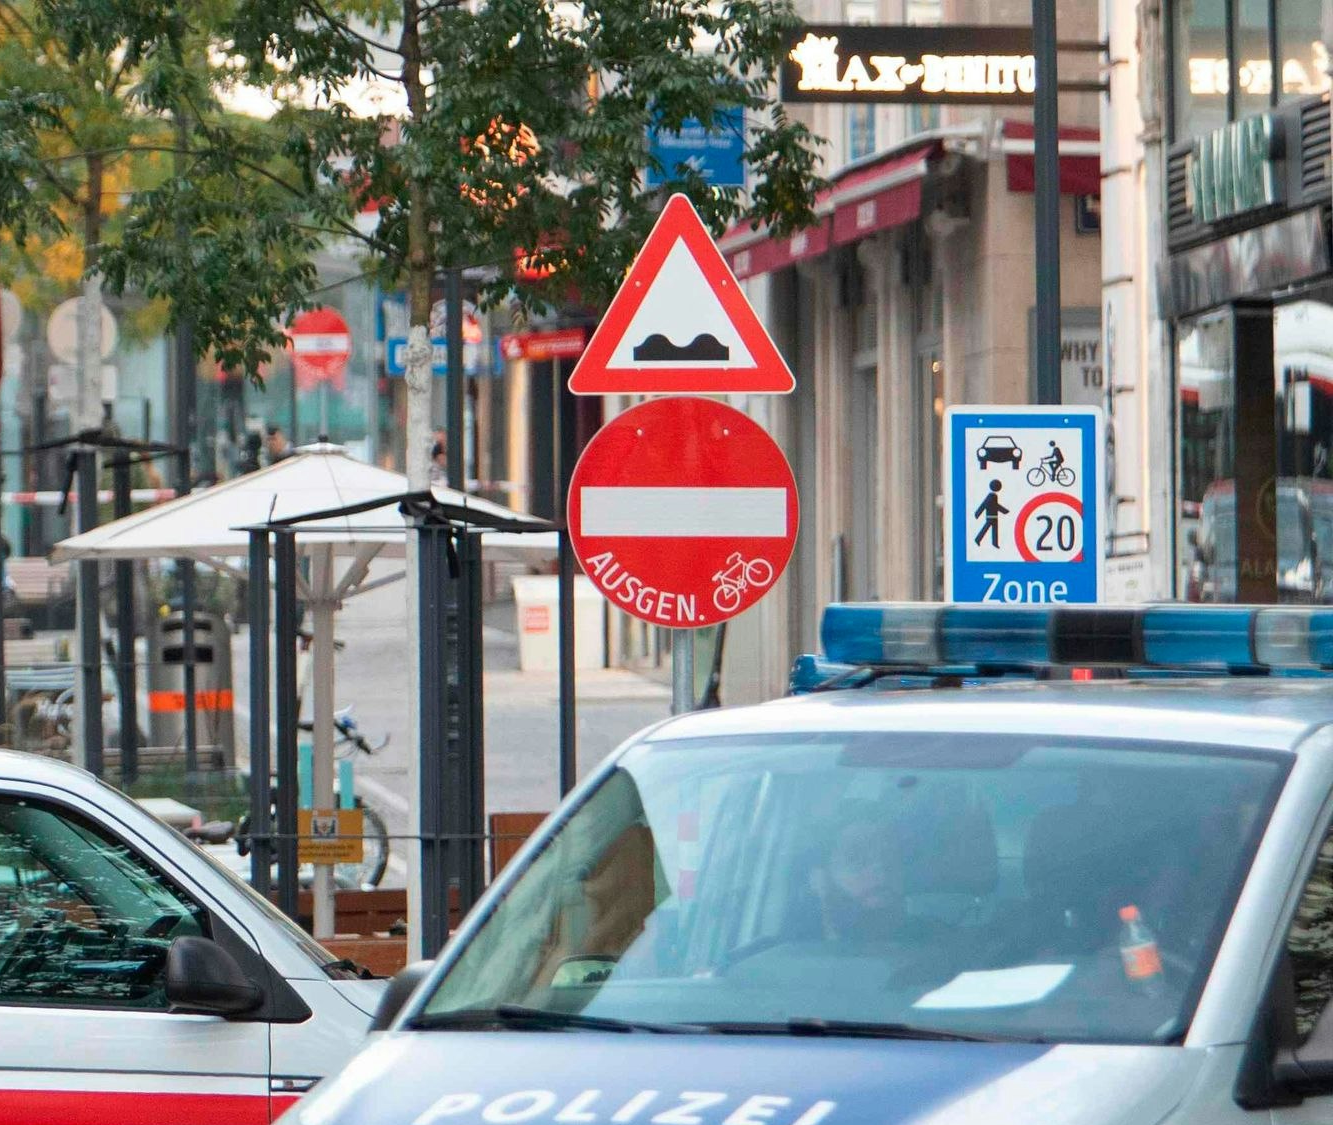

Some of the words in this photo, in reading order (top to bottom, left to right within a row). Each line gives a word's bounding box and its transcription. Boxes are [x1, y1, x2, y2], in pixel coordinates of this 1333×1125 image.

[1036, 515, 1075, 551] 20
[585, 551, 706, 622] AUSGEN.
[983, 573, 1068, 602] Zone
